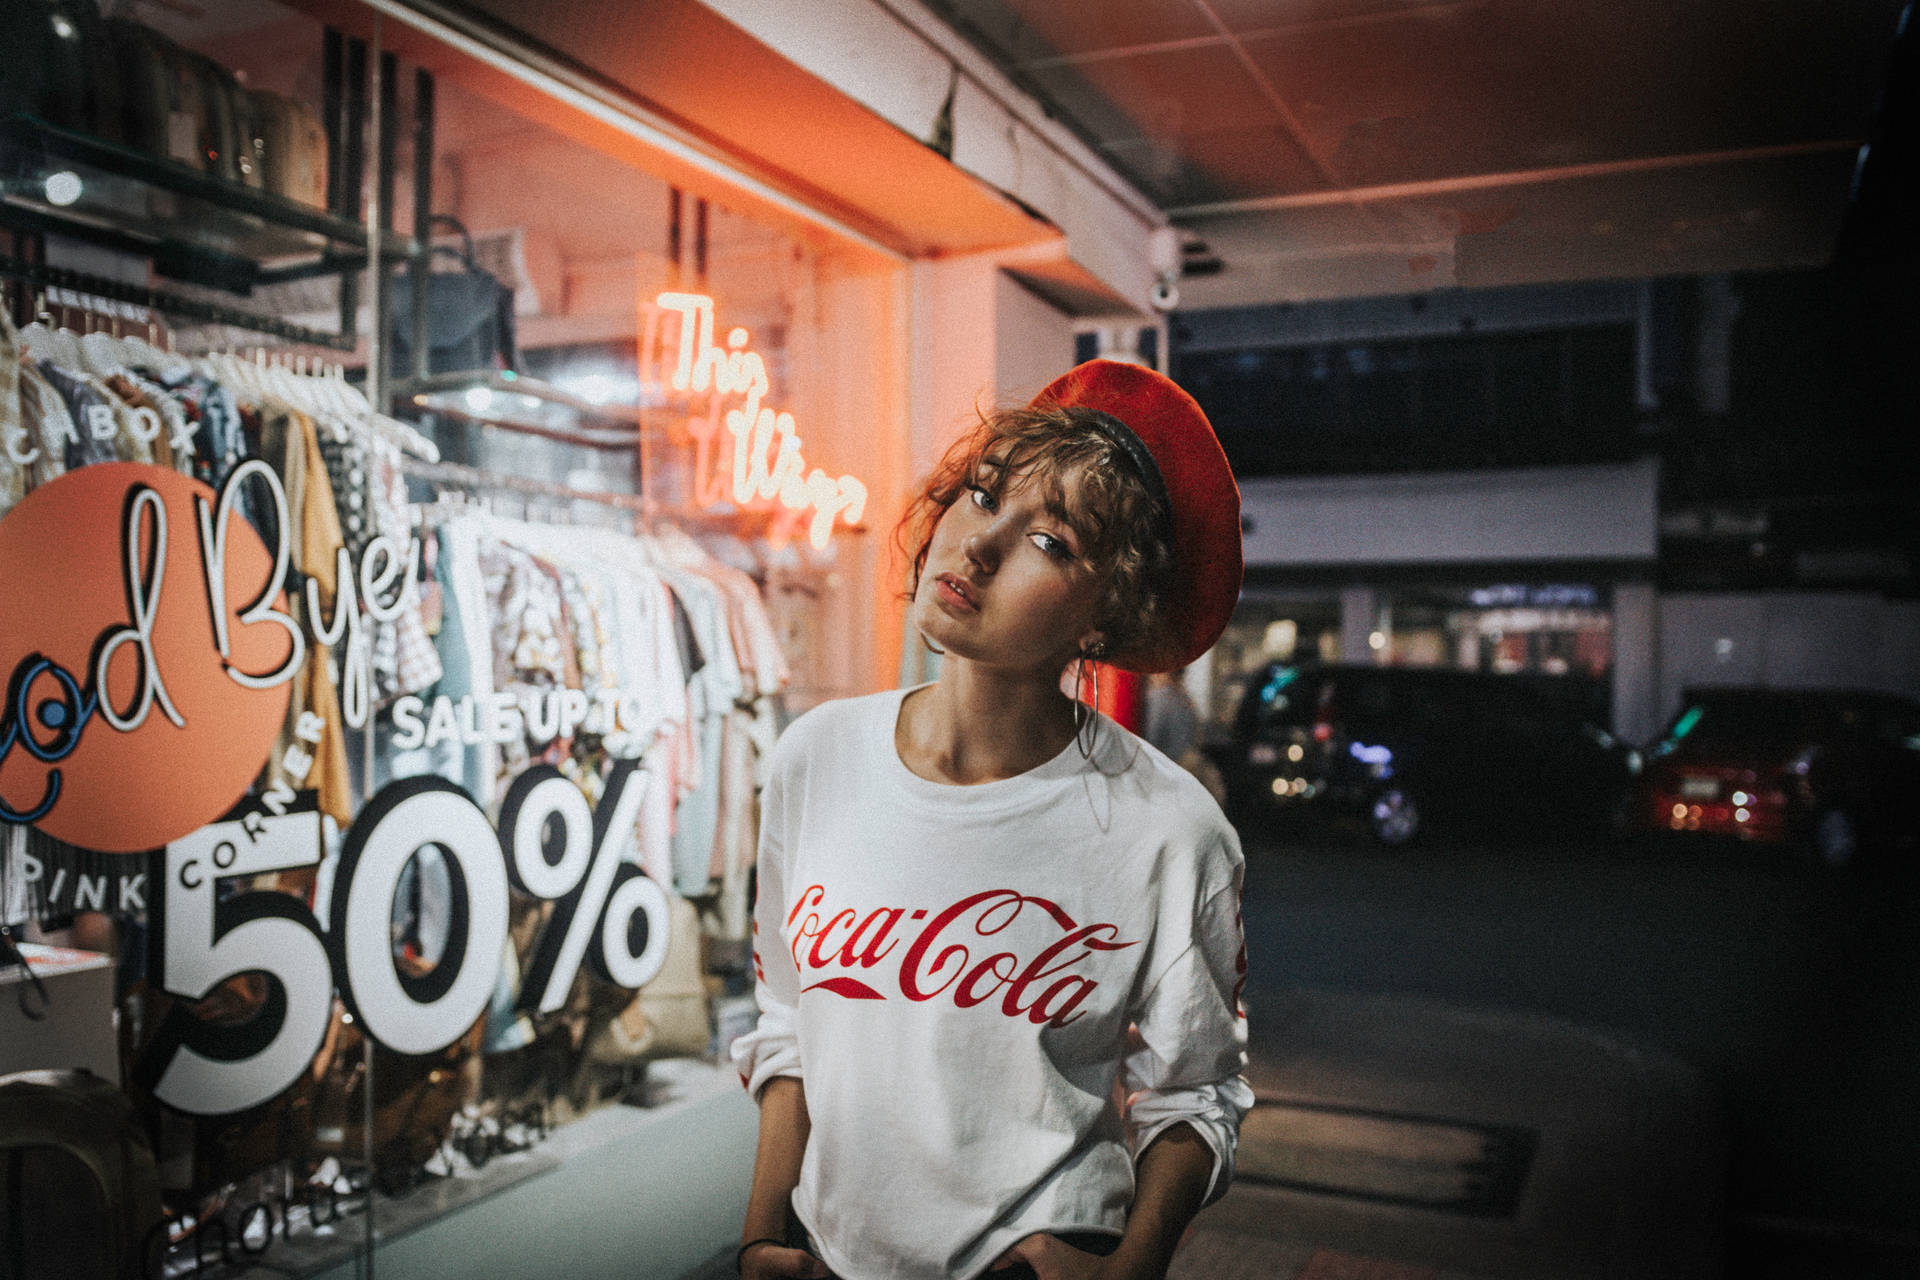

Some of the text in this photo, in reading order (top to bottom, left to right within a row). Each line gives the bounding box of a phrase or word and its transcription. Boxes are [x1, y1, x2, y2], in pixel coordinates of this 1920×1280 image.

[657, 292, 768, 396] This
[0, 459, 420, 760] od Bye
[14, 710, 325, 911] PINK CORNER
[391, 685, 655, 750] SALE UP TO
[154, 770, 670, 1115] 50%
